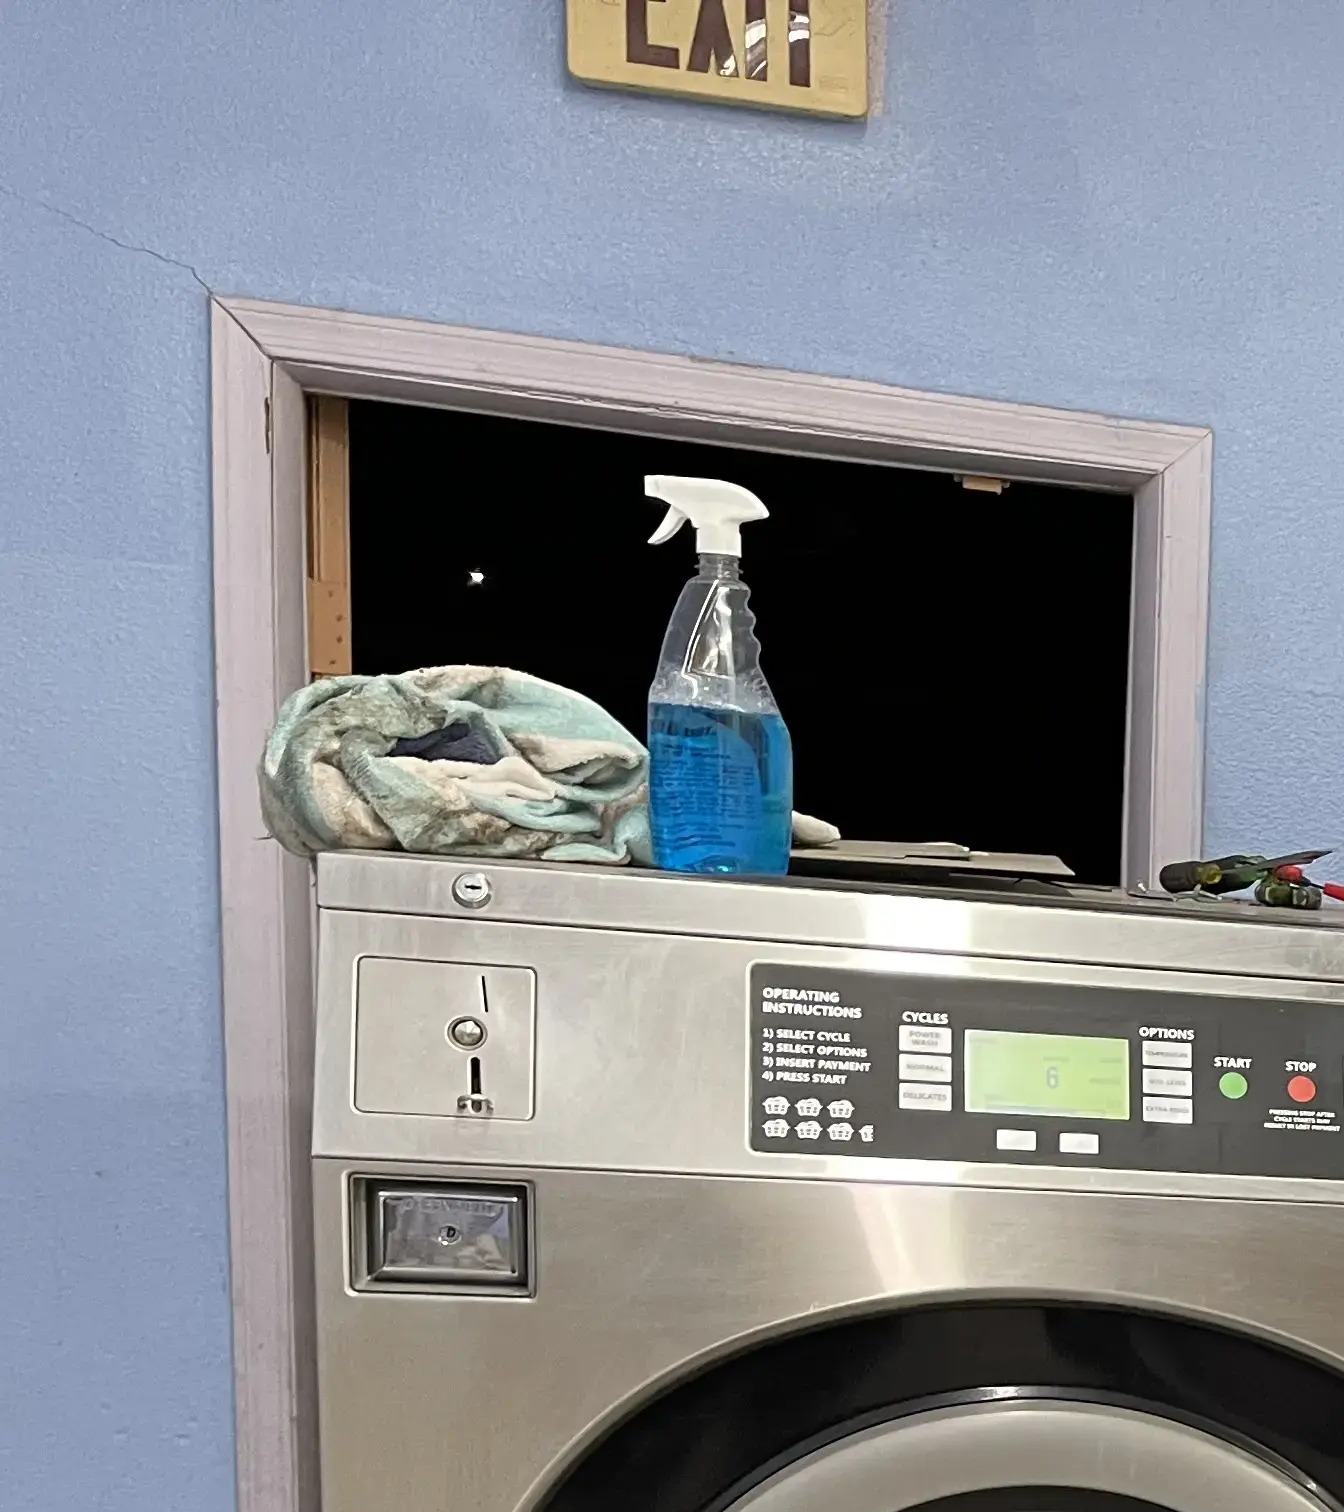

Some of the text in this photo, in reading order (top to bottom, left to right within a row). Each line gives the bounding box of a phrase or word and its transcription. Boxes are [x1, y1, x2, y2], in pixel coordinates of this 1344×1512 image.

[762, 987, 840, 1003] OPERATING
[762, 1000, 863, 1019] INSTRUCTIONS
[902, 1011, 949, 1025] CYCLES
[762, 1028, 851, 1043] 1) SELECT CYCLE
[1138, 1026, 1195, 1041] OPTIONS
[762, 1042, 868, 1058] 2) SELECT OPTIONS
[762, 1056, 872, 1072] 3) INSERT PAYMENT
[1213, 1056, 1253, 1069] START
[1285, 1060, 1317, 1073] STOP
[761, 1070, 848, 1085] 4) PRESS START
[1046, 1066, 1059, 1089] 6
